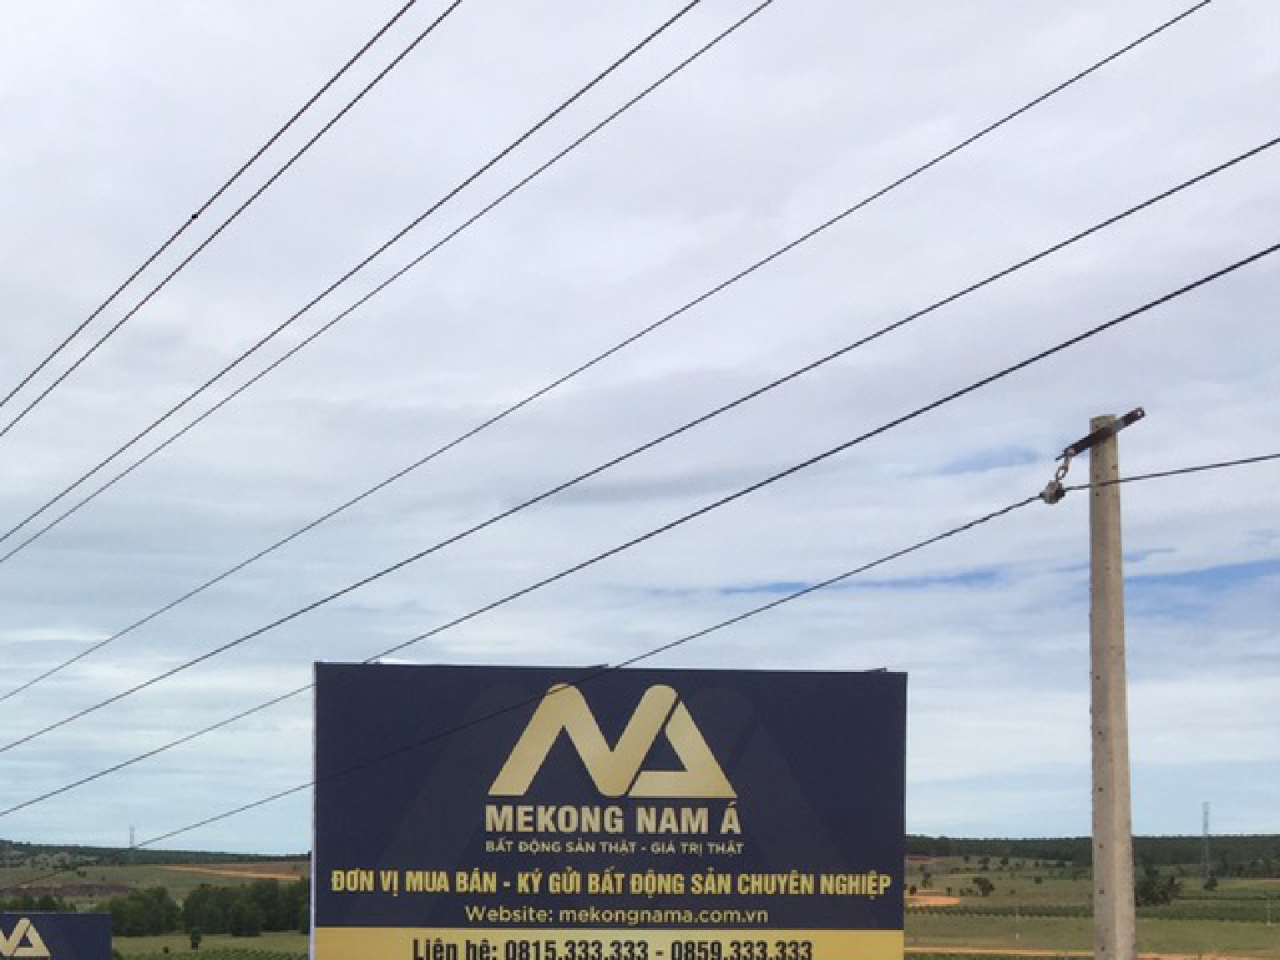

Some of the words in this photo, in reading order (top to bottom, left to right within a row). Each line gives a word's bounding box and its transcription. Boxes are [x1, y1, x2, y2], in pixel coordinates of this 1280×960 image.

[485, 804, 625, 833] MEKONG
[636, 806, 709, 835] NAM
[720, 801, 742, 835] Á
[331, 868, 374, 893] ĐƠN
[379, 870, 399, 897] VỊ
[405, 870, 450, 893] MUA
[456, 867, 497, 893] BÁN
[517, 868, 543, 894] KÝ
[587, 866, 625, 895] BẤT
[630, 869, 685, 898] ĐỘNG
[690, 866, 732, 895] SẢN
[737, 869, 815, 895] CHUYÊN
[820, 869, 892, 900] NGHIỆP
[464, 905, 553, 923] Website:
[559, 906, 769, 926] mekongnama.com.vn
